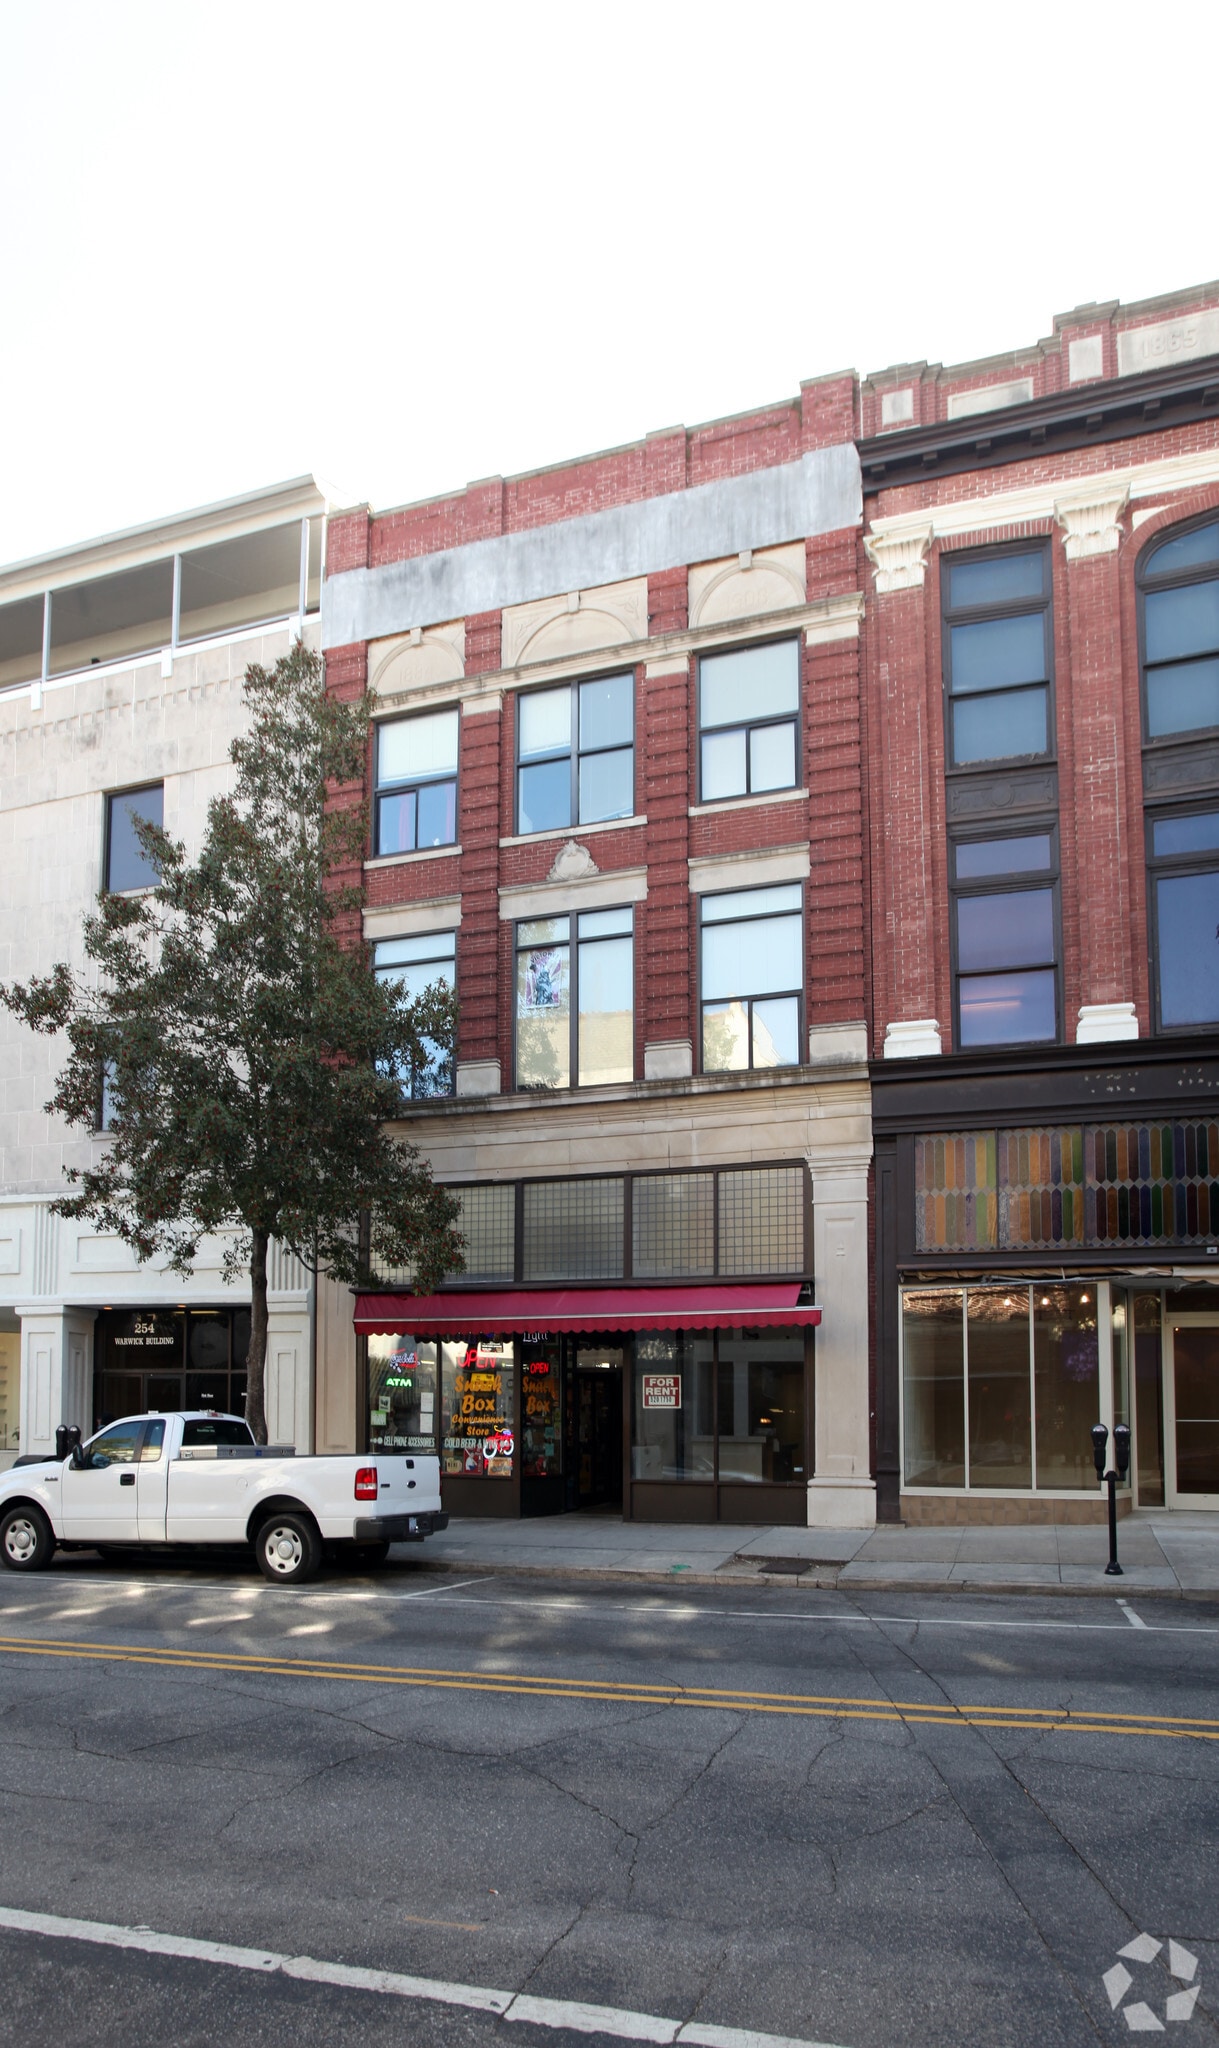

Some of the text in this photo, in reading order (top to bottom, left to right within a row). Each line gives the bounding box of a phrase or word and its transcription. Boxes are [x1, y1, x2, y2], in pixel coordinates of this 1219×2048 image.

[1142, 329, 1199, 359] 1865
[134, 1323, 155, 1333] 254
[145, 1337, 174, 1345] BUILDING
[457, 1349, 497, 1369] OPEN
[530, 1362, 549, 1374] OPEN
[386, 1378, 413, 1387] ATM
[649, 1378, 674, 1386] FOR
[645, 1387, 678, 1395] RENT
[462, 1394, 496, 1414] Box
[526, 1395, 550, 1414] Box
[451, 1413, 505, 1424] Convenience
[467, 1426, 490, 1436] Store
[384, 1436, 435, 1447] CELL PHONE ACCESSORIES
[445, 1438, 460, 1448] COLD
[461, 1438, 476, 1448] BEER
